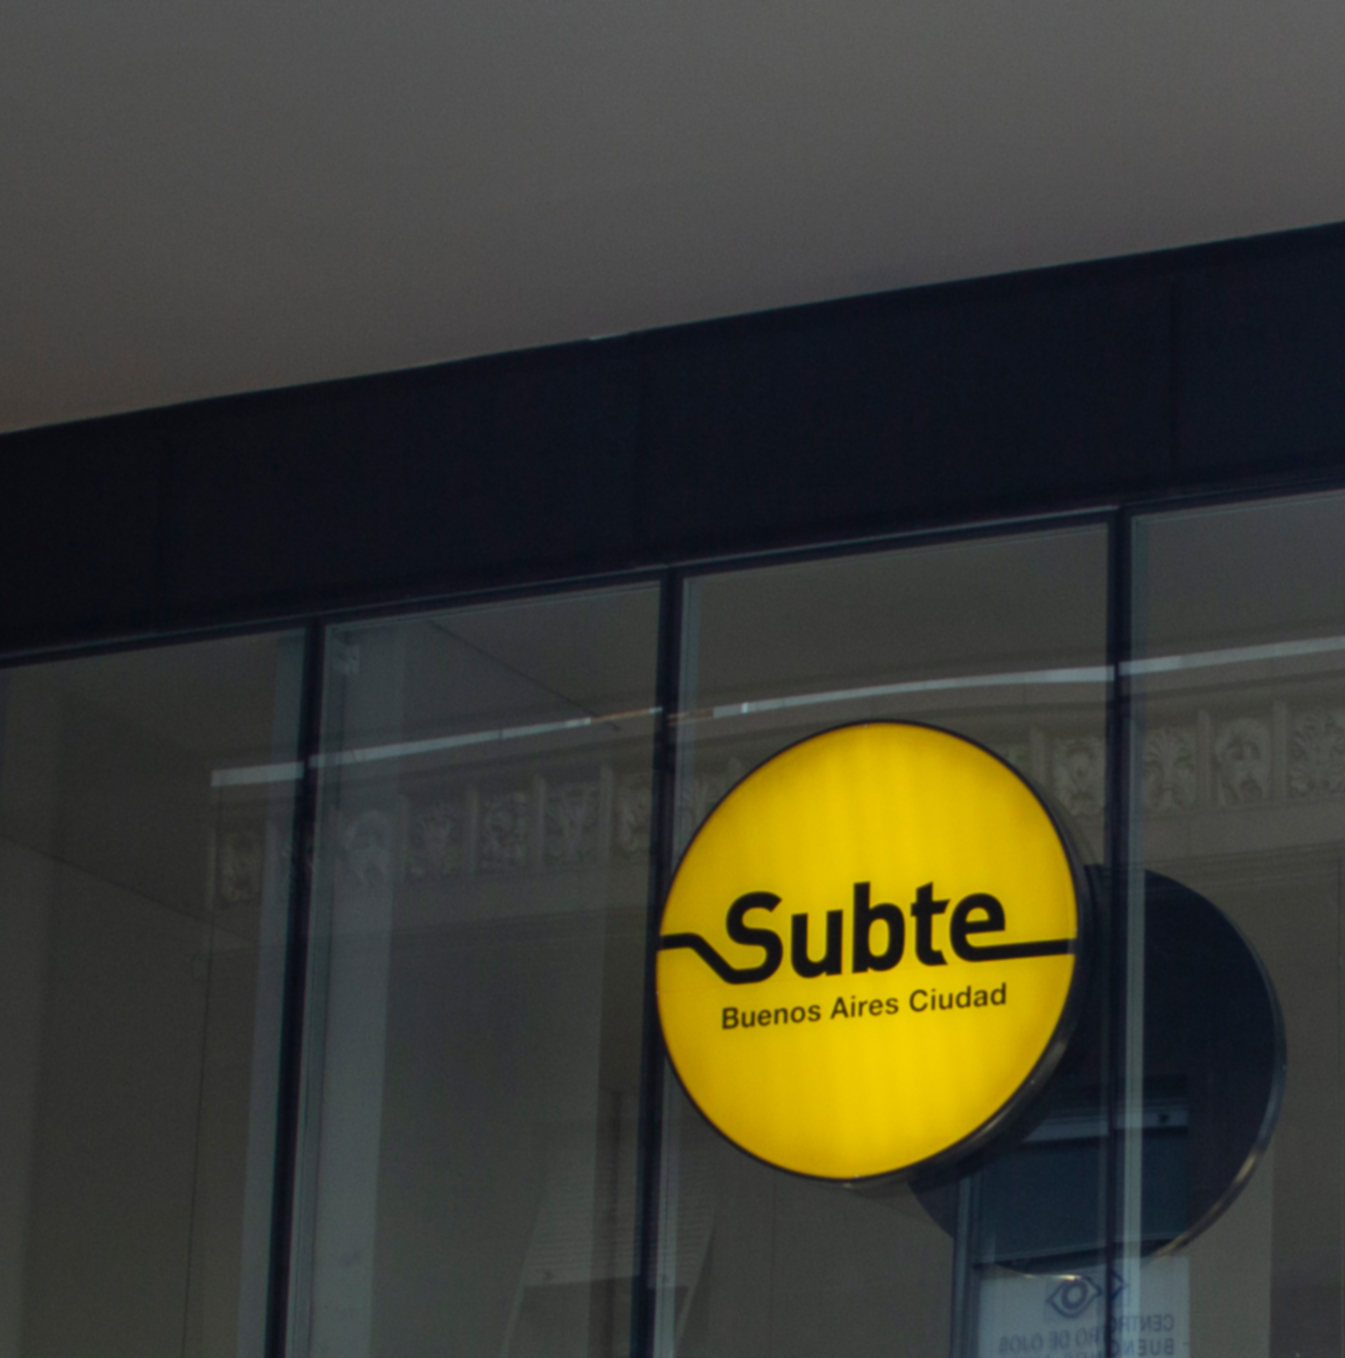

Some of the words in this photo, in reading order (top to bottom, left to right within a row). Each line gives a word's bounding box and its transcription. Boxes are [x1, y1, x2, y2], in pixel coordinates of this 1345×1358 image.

[719, 880, 1008, 985] Subte
[721, 1005, 822, 1031] Buenos
[829, 993, 900, 1020] Aires
[908, 982, 1008, 1013] Ciudad
